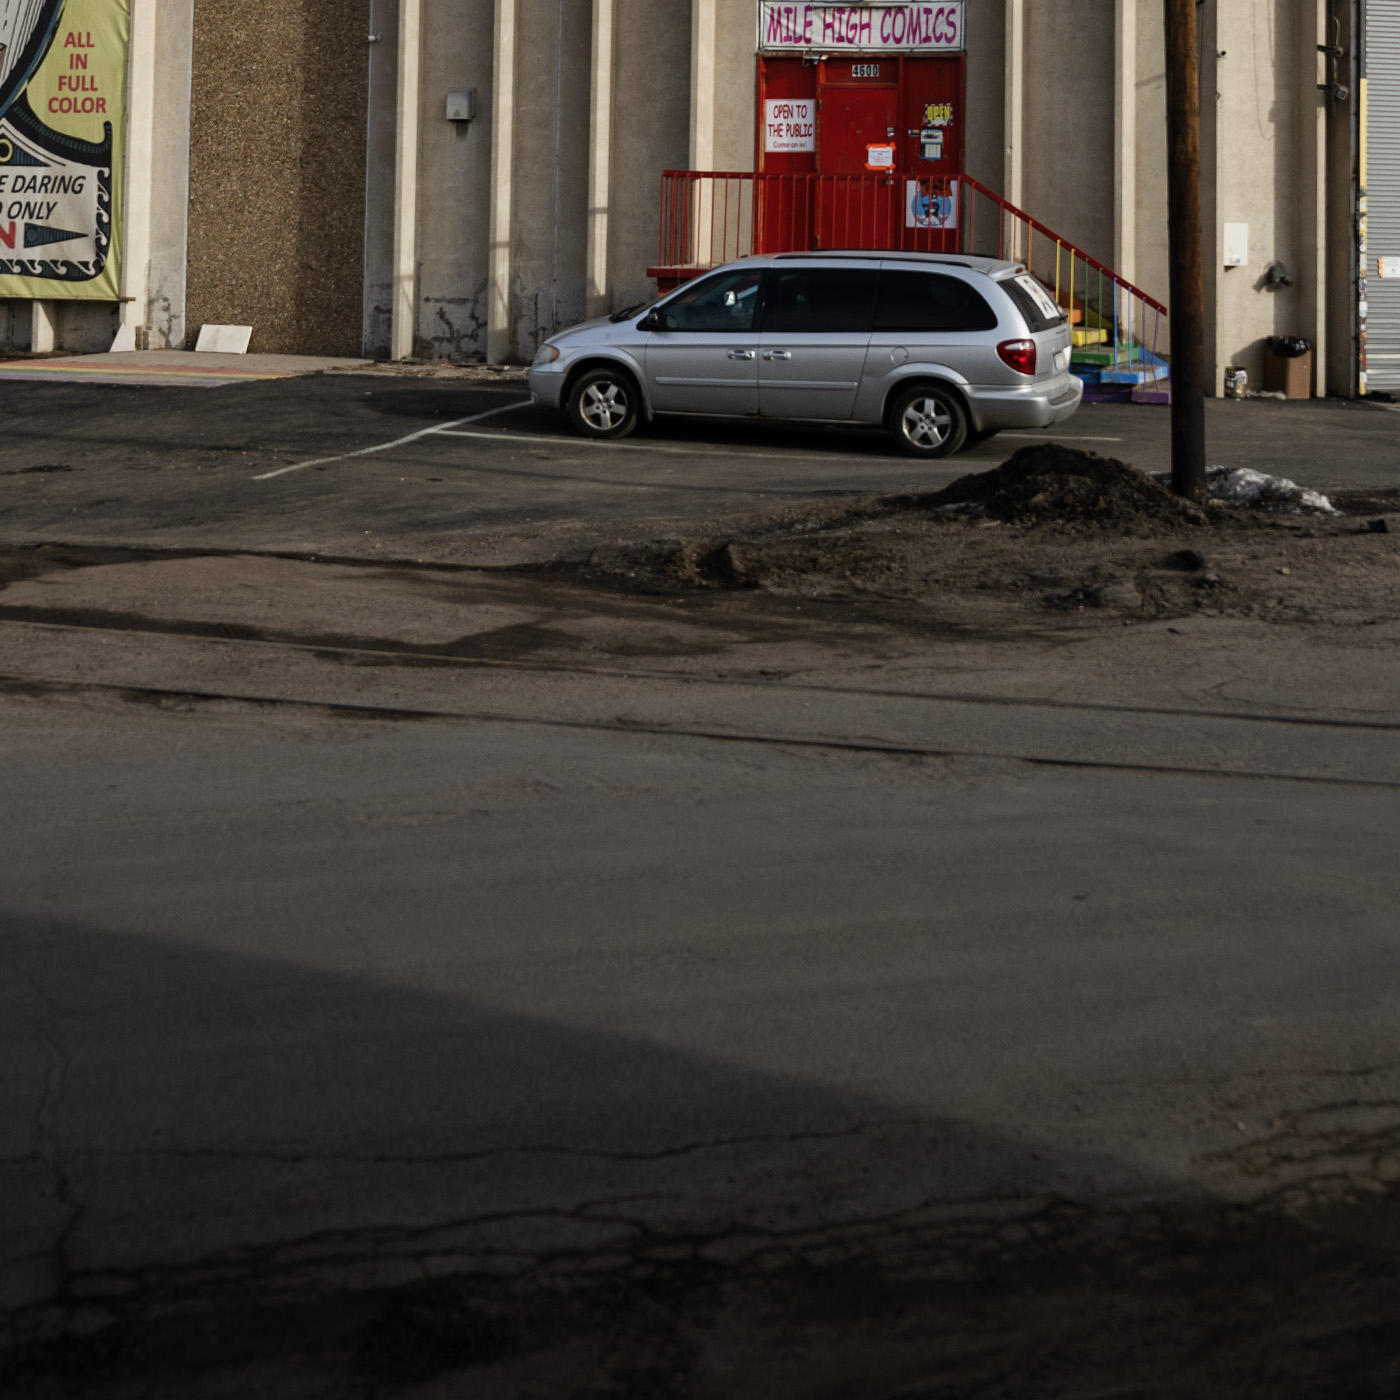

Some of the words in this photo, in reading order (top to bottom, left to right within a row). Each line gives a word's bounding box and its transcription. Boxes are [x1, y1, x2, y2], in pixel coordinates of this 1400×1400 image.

[767, 5, 813, 44] MILE
[823, 6, 872, 44] HIGH
[880, 7, 956, 45] COMICS
[64, 31, 95, 48] ALL
[70, 54, 88, 70] IN
[853, 65, 878, 76] 4600
[58, 75, 98, 92] FULL
[48, 97, 107, 114] COLOR
[773, 104, 794, 119] OPEN
[796, 105, 808, 119] TO
[927, 105, 950, 120] OPEN
[768, 123, 783, 138] THE
[786, 122, 813, 138] PUBLIC
[11, 175, 87, 194] DARING
[7, 201, 58, 220] ONLY
